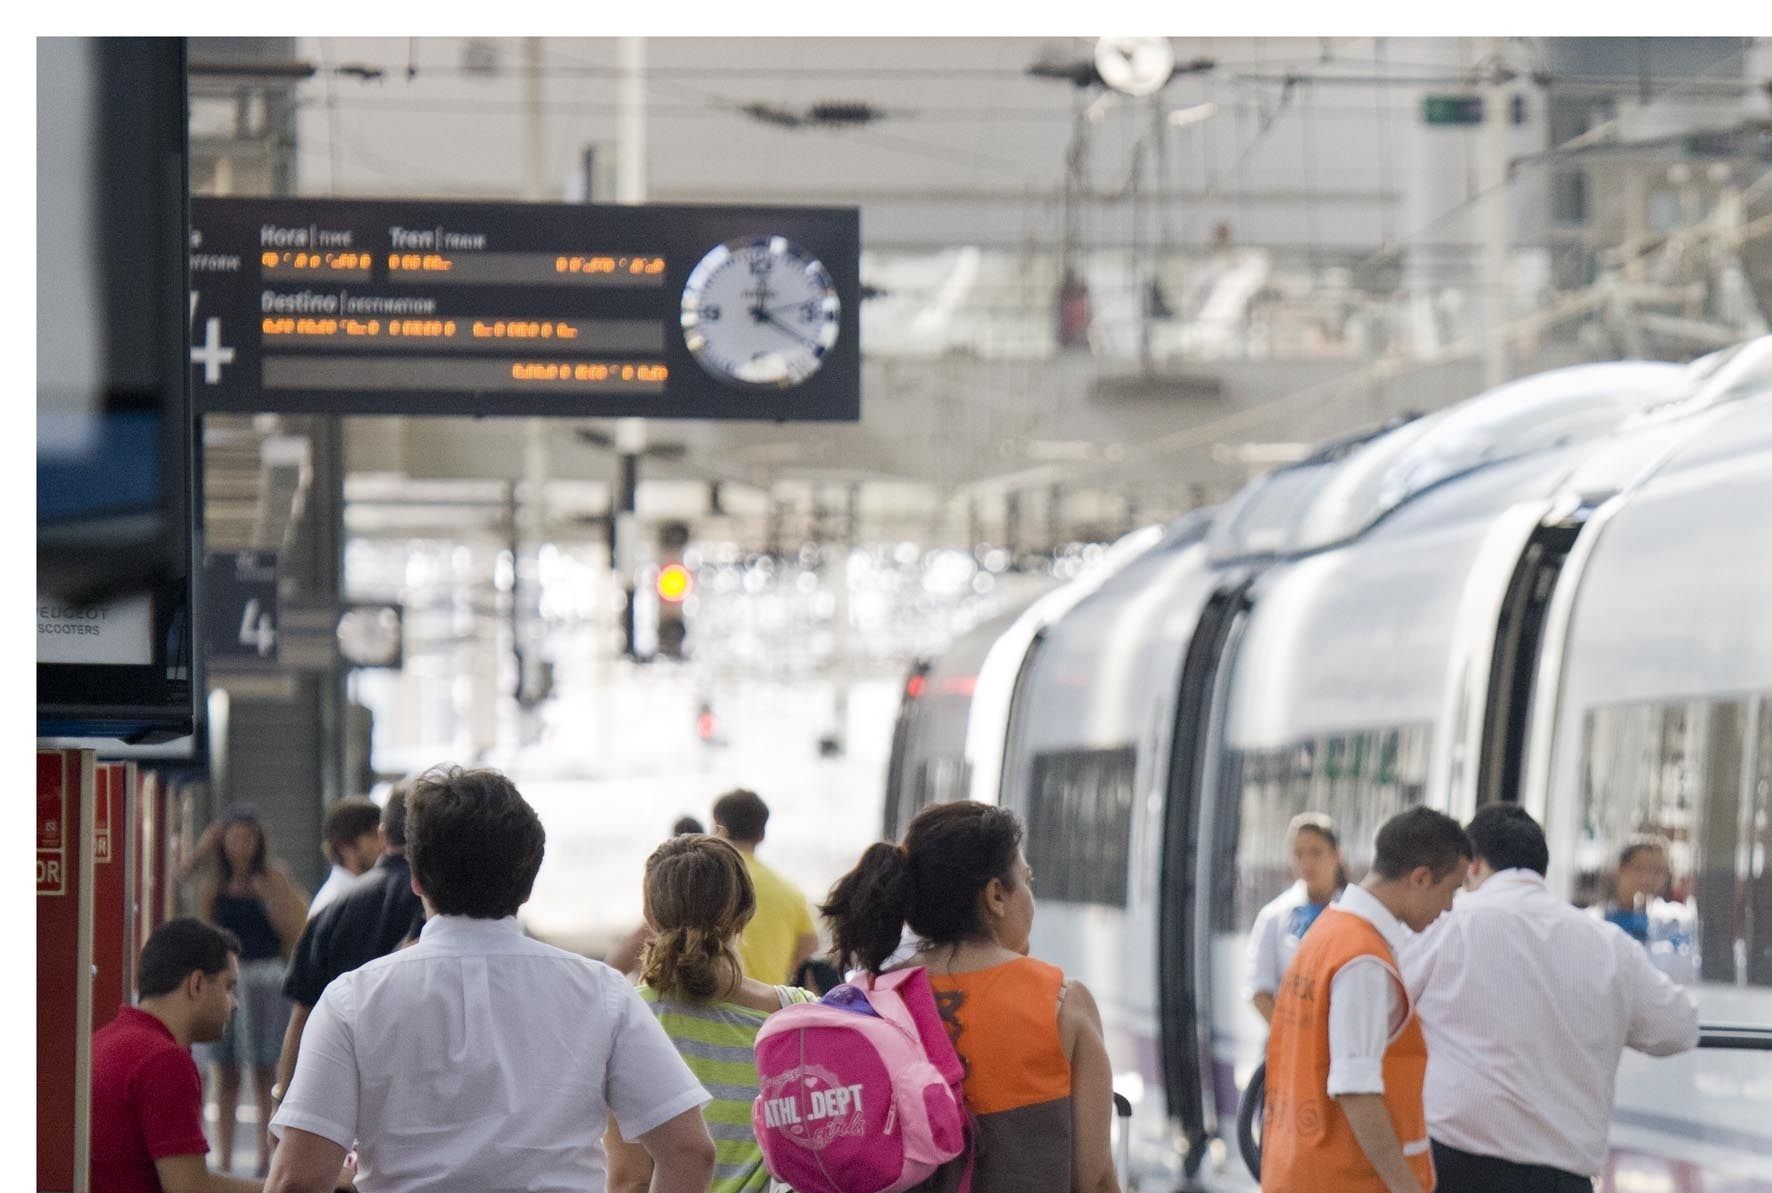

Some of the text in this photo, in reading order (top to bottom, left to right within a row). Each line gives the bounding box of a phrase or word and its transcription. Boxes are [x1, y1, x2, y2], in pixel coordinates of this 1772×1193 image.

[261, 225, 308, 247] Hora
[390, 226, 434, 247] Tren
[262, 290, 337, 313] Destino
[38, 623, 100, 636] SCOOTERS
[239, 597, 275, 657] 4
